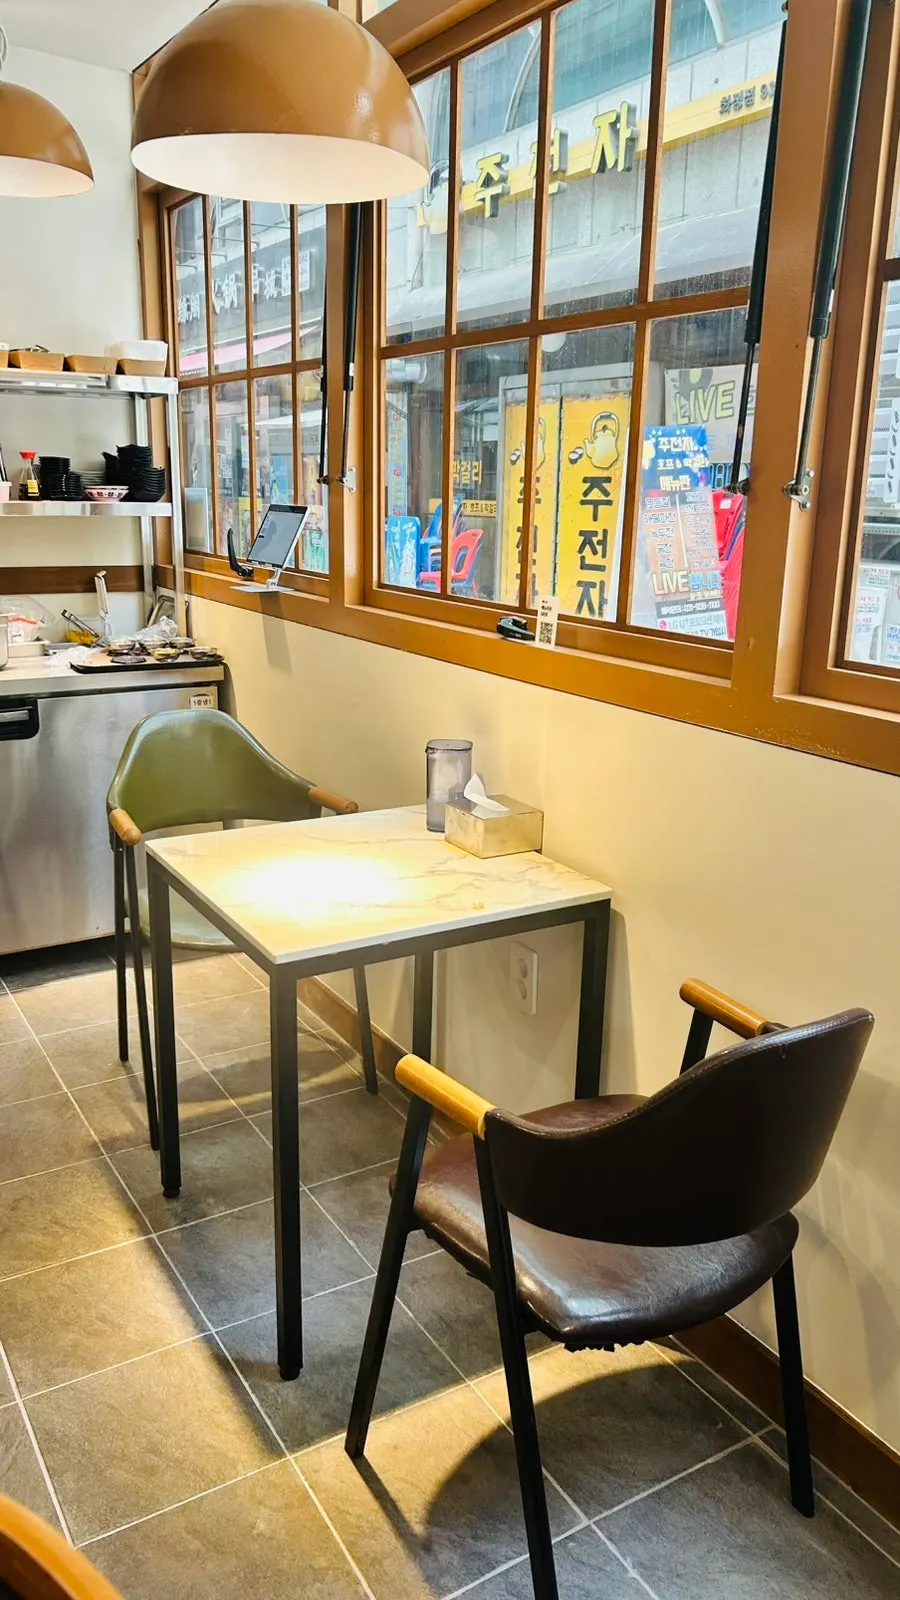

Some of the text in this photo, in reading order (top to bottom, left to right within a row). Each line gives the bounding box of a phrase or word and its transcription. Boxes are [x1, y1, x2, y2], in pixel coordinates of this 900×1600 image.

[674, 380, 736, 425] LIVE
[657, 436, 694, 453] 주전자
[659, 475, 691, 492] 메뉴판
[576, 476, 615, 618] 주전자
[652, 571, 689, 596] LIVE
